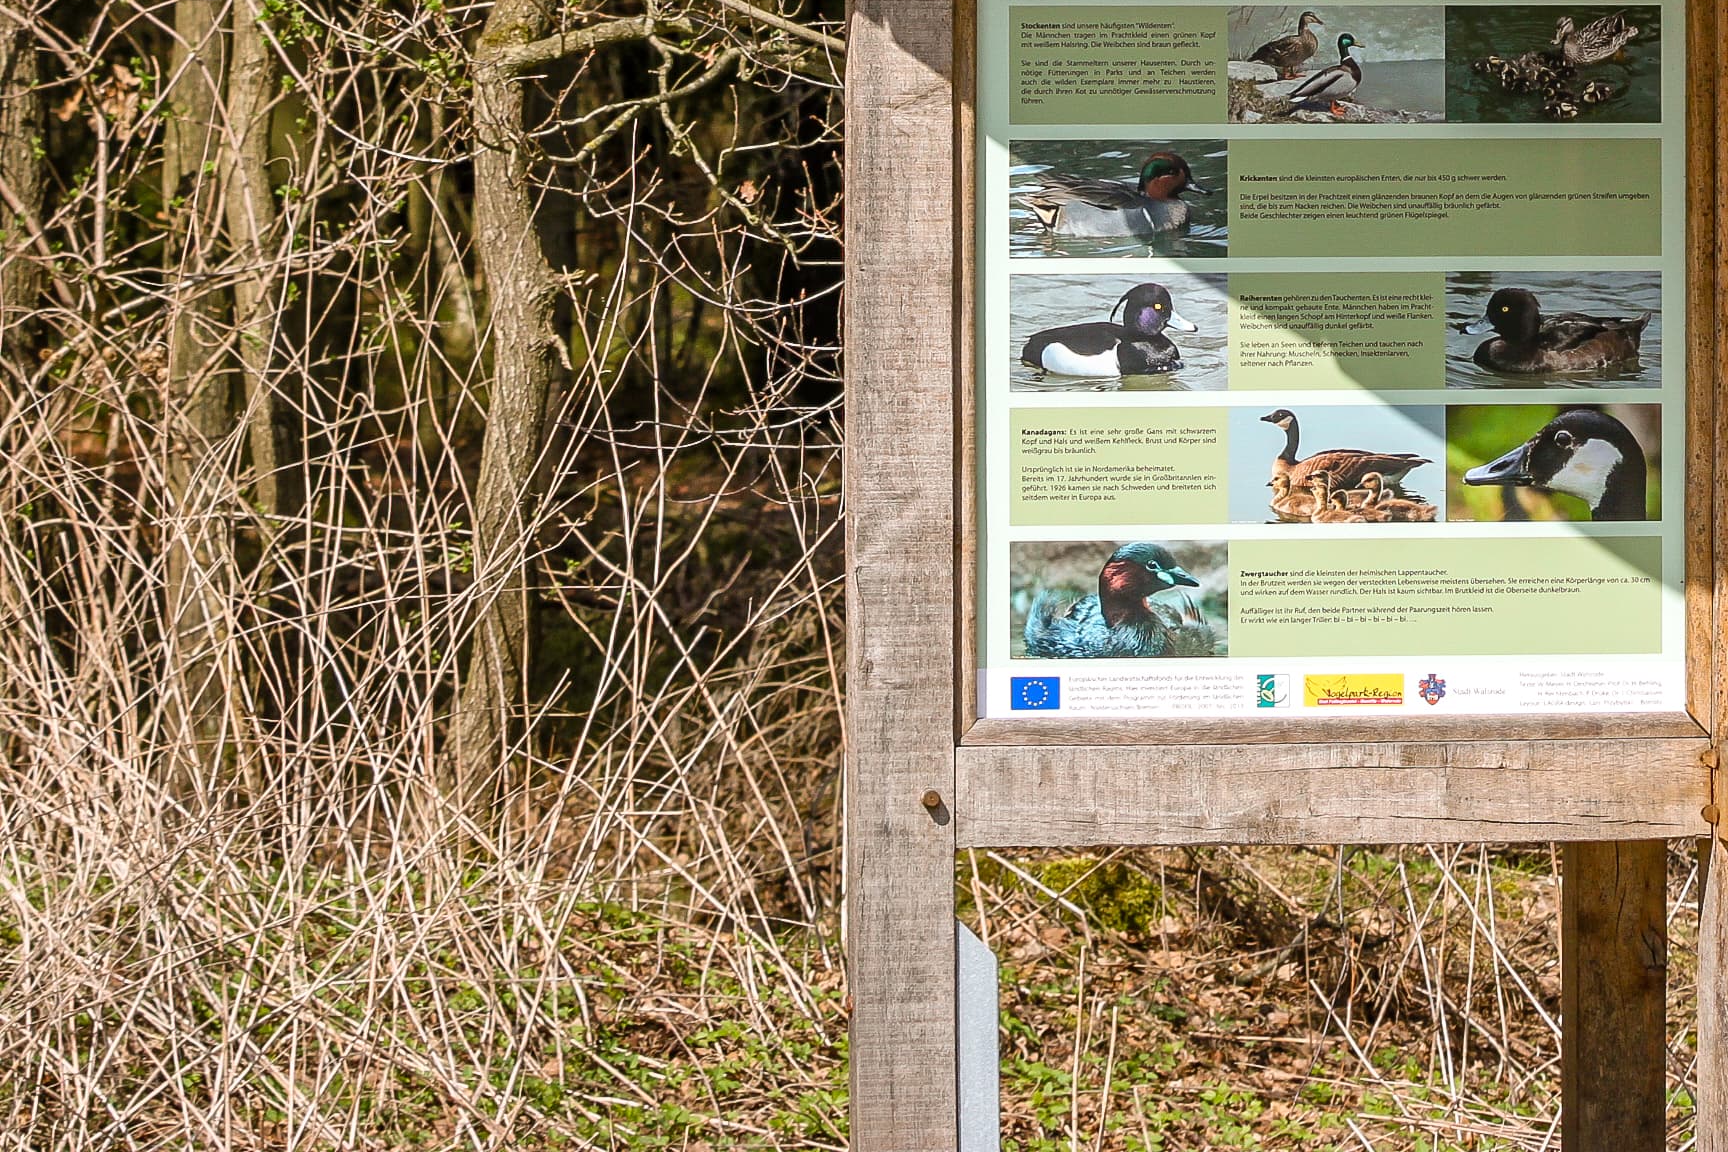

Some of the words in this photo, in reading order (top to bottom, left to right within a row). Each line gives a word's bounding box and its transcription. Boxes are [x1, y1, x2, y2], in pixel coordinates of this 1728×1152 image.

[1099, 22, 1134, 31] häufigsten
[1035, 31, 1073, 39] Männchen
[1073, 32, 1098, 40] tragen
[1110, 31, 1150, 39] Prachtkleid
[1172, 31, 1199, 40] grünen
[1199, 31, 1216, 40] Kopf
[1239, 174, 1278, 182] Krickenten
[1278, 174, 1292, 182] sind
[1305, 174, 1335, 182] kleinsten
[1336, 174, 1380, 183] europäischen
[1380, 174, 1402, 182] Enten,
[1021, 428, 1068, 437] Kanadagans:
[1124, 428, 1145, 437] große
[1179, 427, 1217, 435] schwarzem
[1240, 569, 1288, 579] Zwergtaucher
[1289, 569, 1304, 577] sind
[1397, 568, 1448, 578] Lappentaucher.
[1322, 688, 1402, 699] Vogelpark-Region
